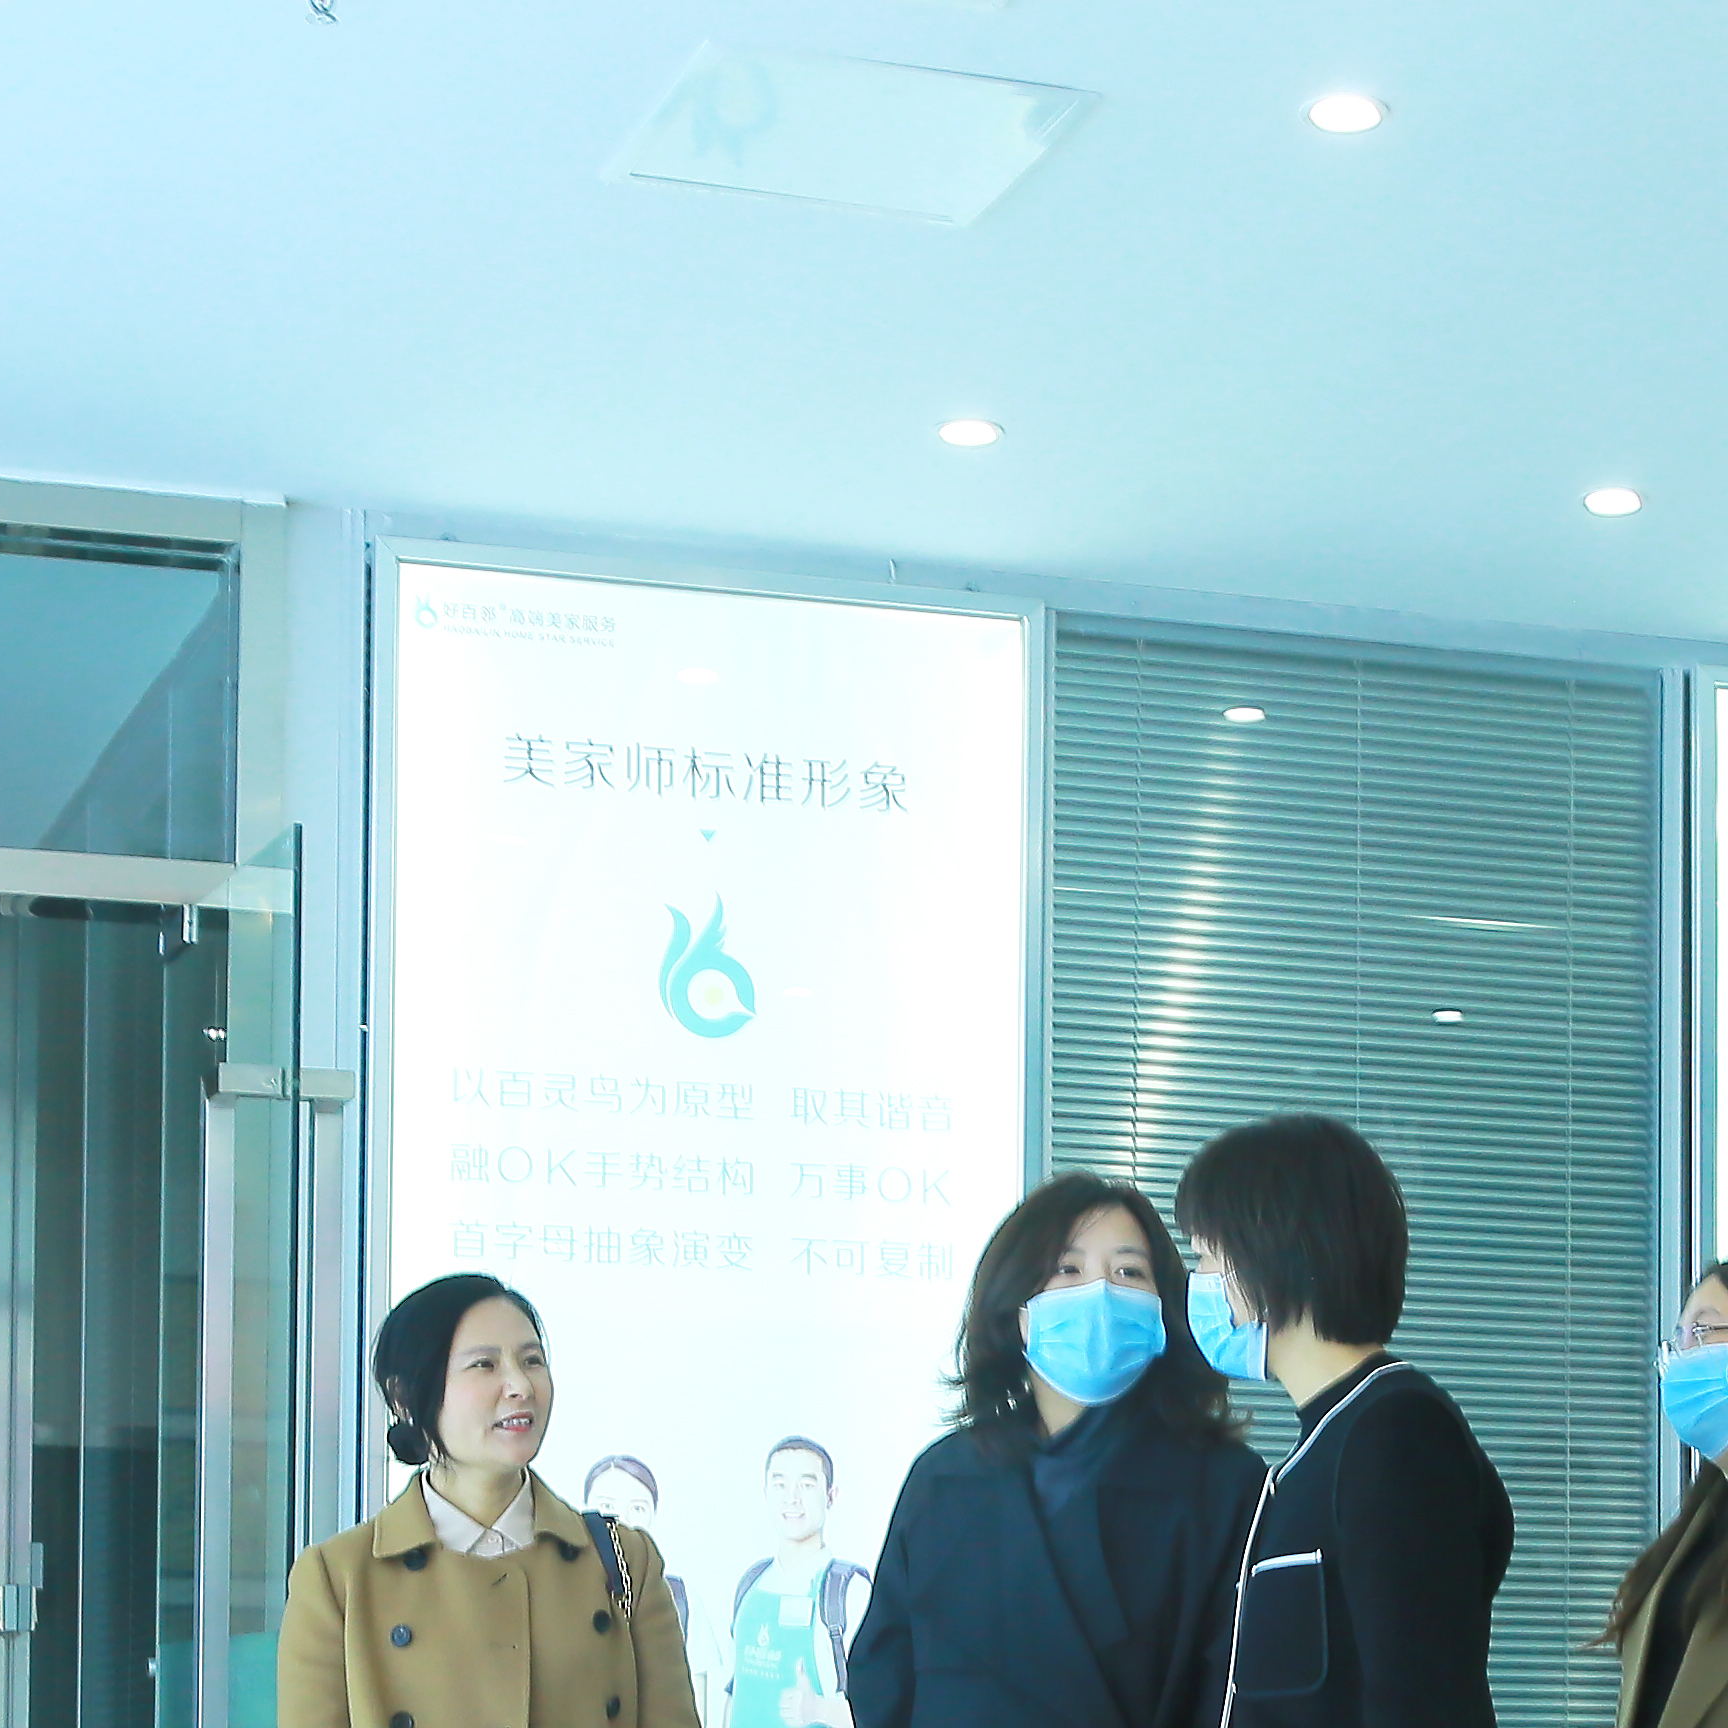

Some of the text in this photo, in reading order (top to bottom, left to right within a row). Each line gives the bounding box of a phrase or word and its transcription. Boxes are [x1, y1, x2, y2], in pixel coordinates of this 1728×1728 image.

[503, 731, 909, 814] 美家师标准形象
[451, 1065, 955, 1136] 以百灵鸟为原型 取其谐音
[449, 1141, 955, 1209] 融OK手势结构 万事OK
[450, 1218, 955, 1284] 首字母抽象演变 不可复制
